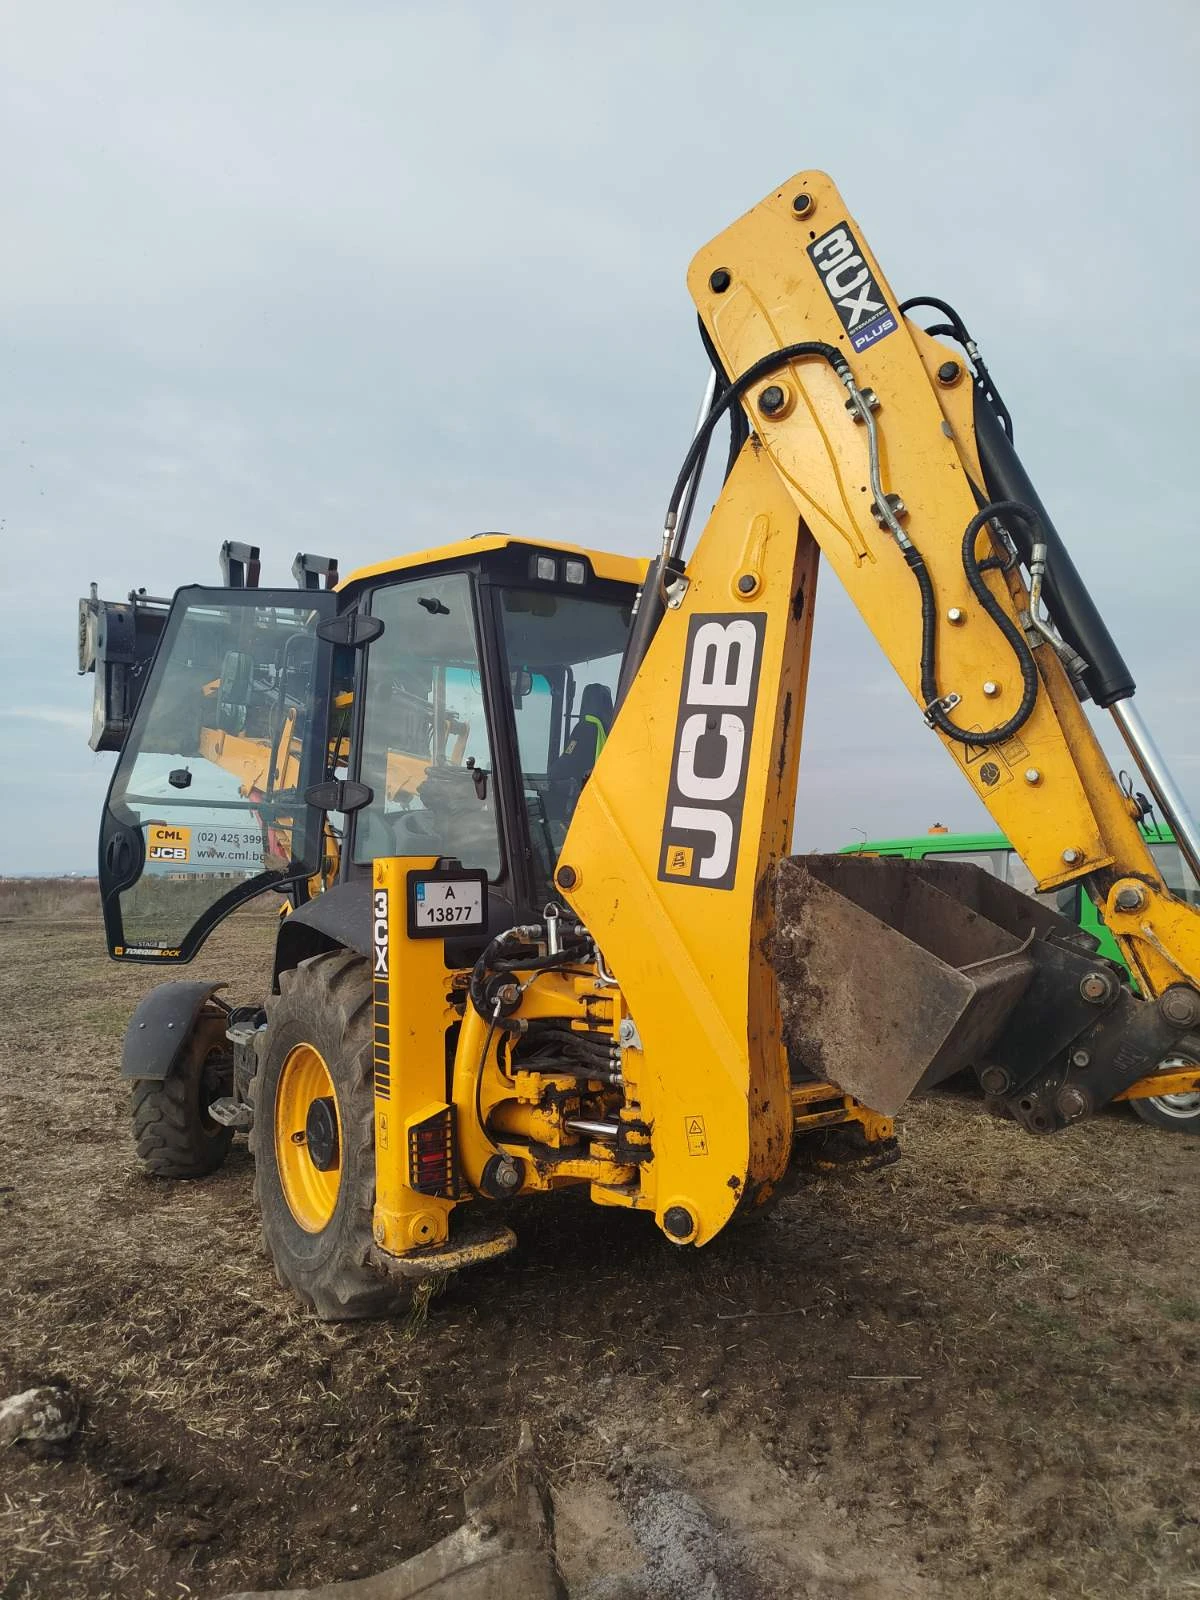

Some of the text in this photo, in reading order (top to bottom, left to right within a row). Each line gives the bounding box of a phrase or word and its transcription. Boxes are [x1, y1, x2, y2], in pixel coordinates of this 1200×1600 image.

[813, 228, 885, 330] 3CX
[855, 319, 894, 348] PLUS
[671, 620, 756, 880] JCB
[156, 830, 182, 841] CML
[197, 832, 217, 843] (02)
[220, 833, 240, 843] 425
[150, 847, 186, 860] JCB
[197, 850, 266, 863] www.cml.bg
[445, 886, 456, 900] A
[427, 906, 472, 923] 13877
[374, 891, 388, 973] 3CX
